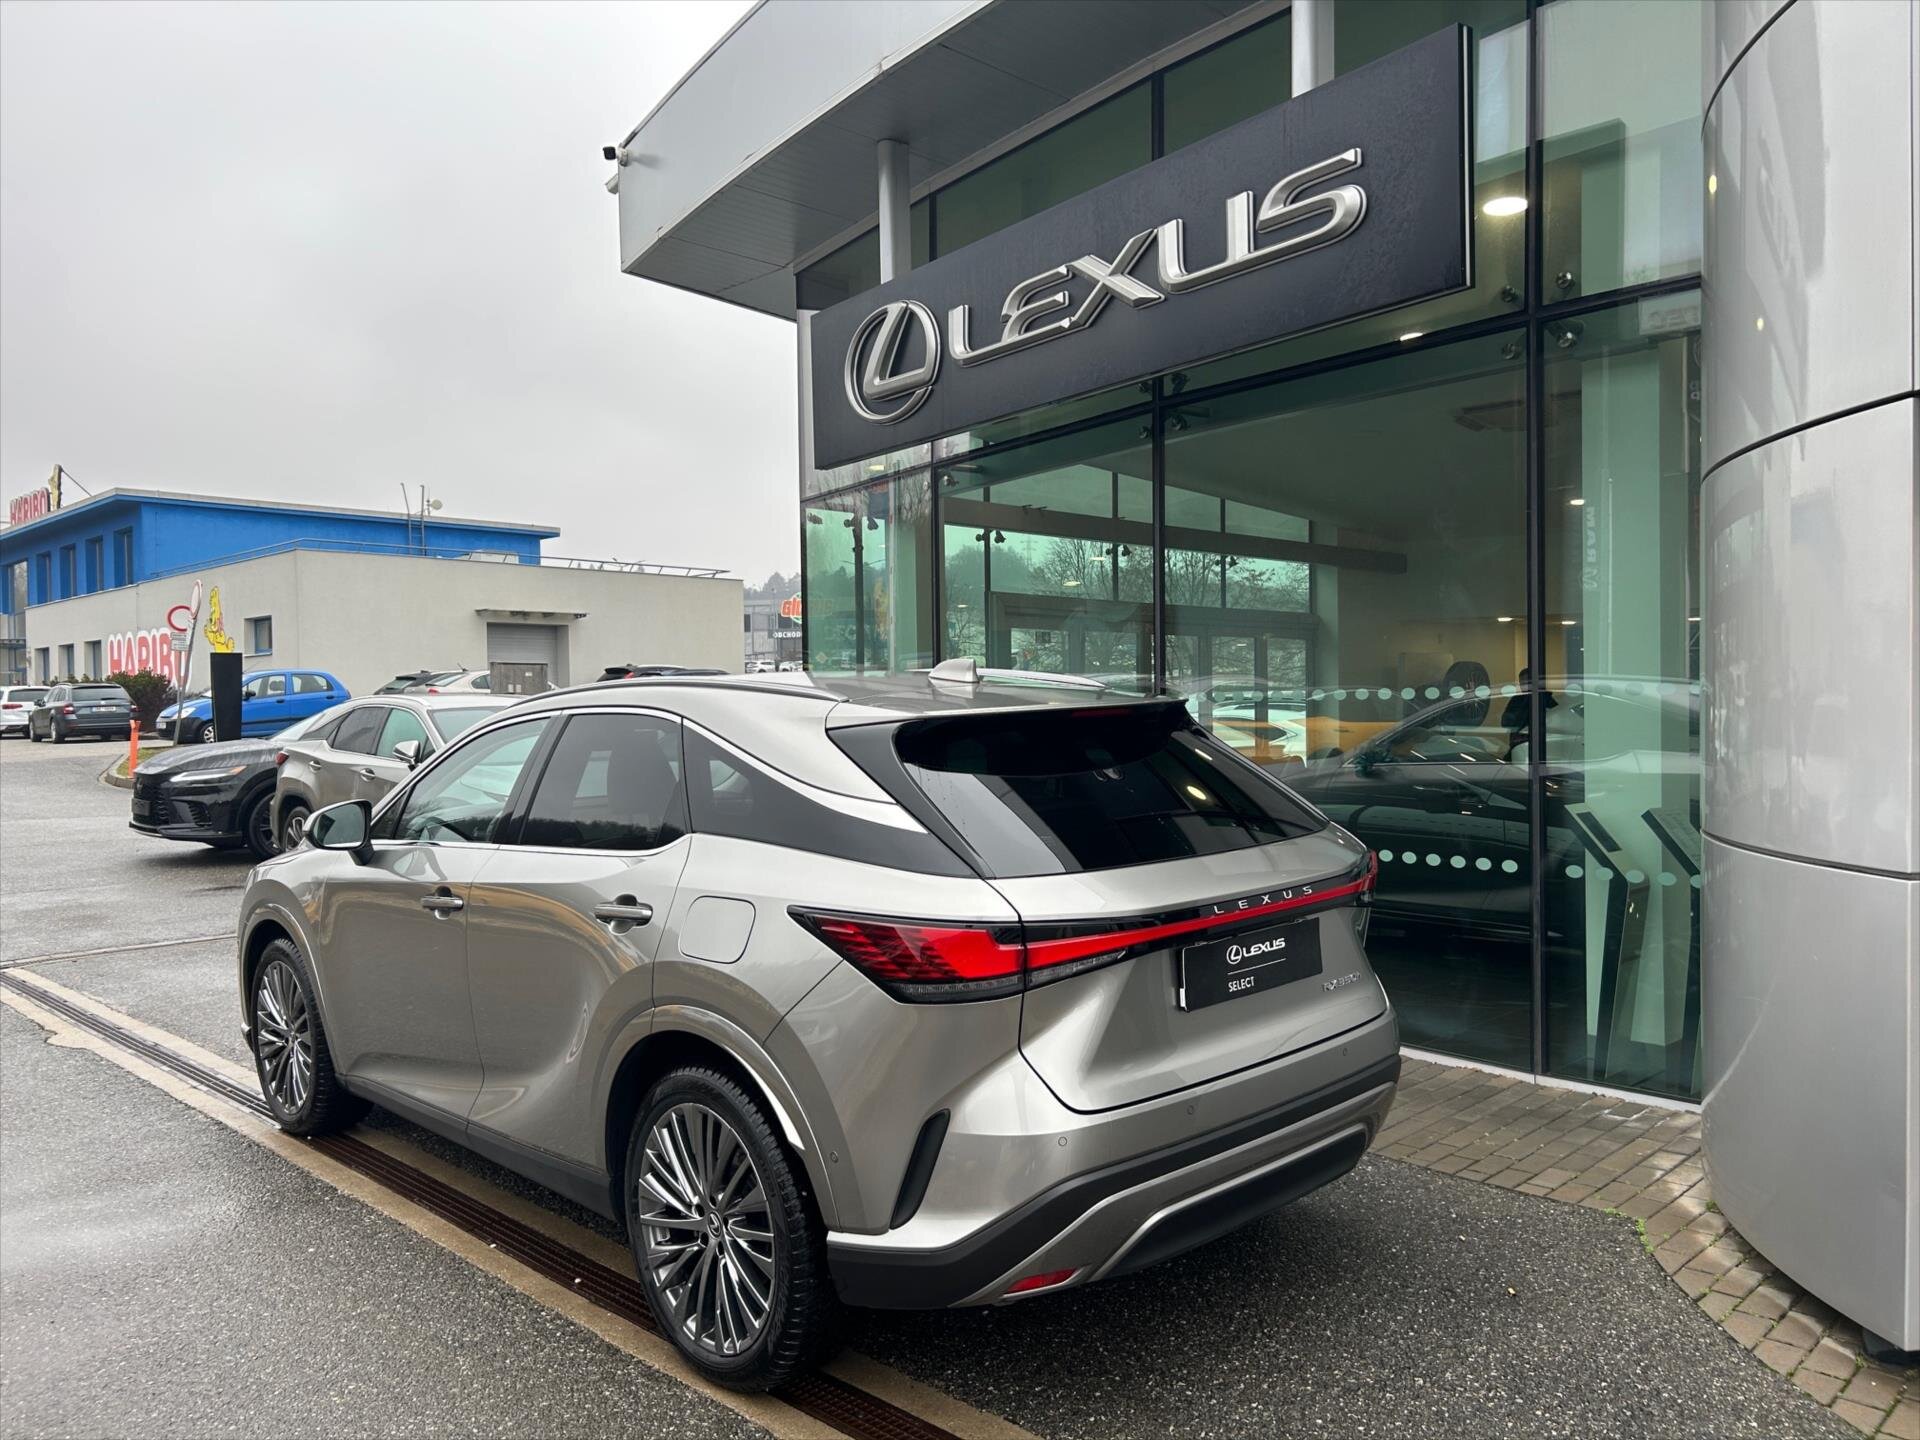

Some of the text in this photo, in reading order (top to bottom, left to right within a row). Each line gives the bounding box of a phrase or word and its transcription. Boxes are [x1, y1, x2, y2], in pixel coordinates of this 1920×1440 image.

[948, 147, 1368, 368] LEXUS
[10, 487, 50, 525] HARIBO
[1214, 886, 1312, 914] LEXUS
[1242, 937, 1286, 957] LEXUS
[1228, 976, 1255, 993] SELECT
